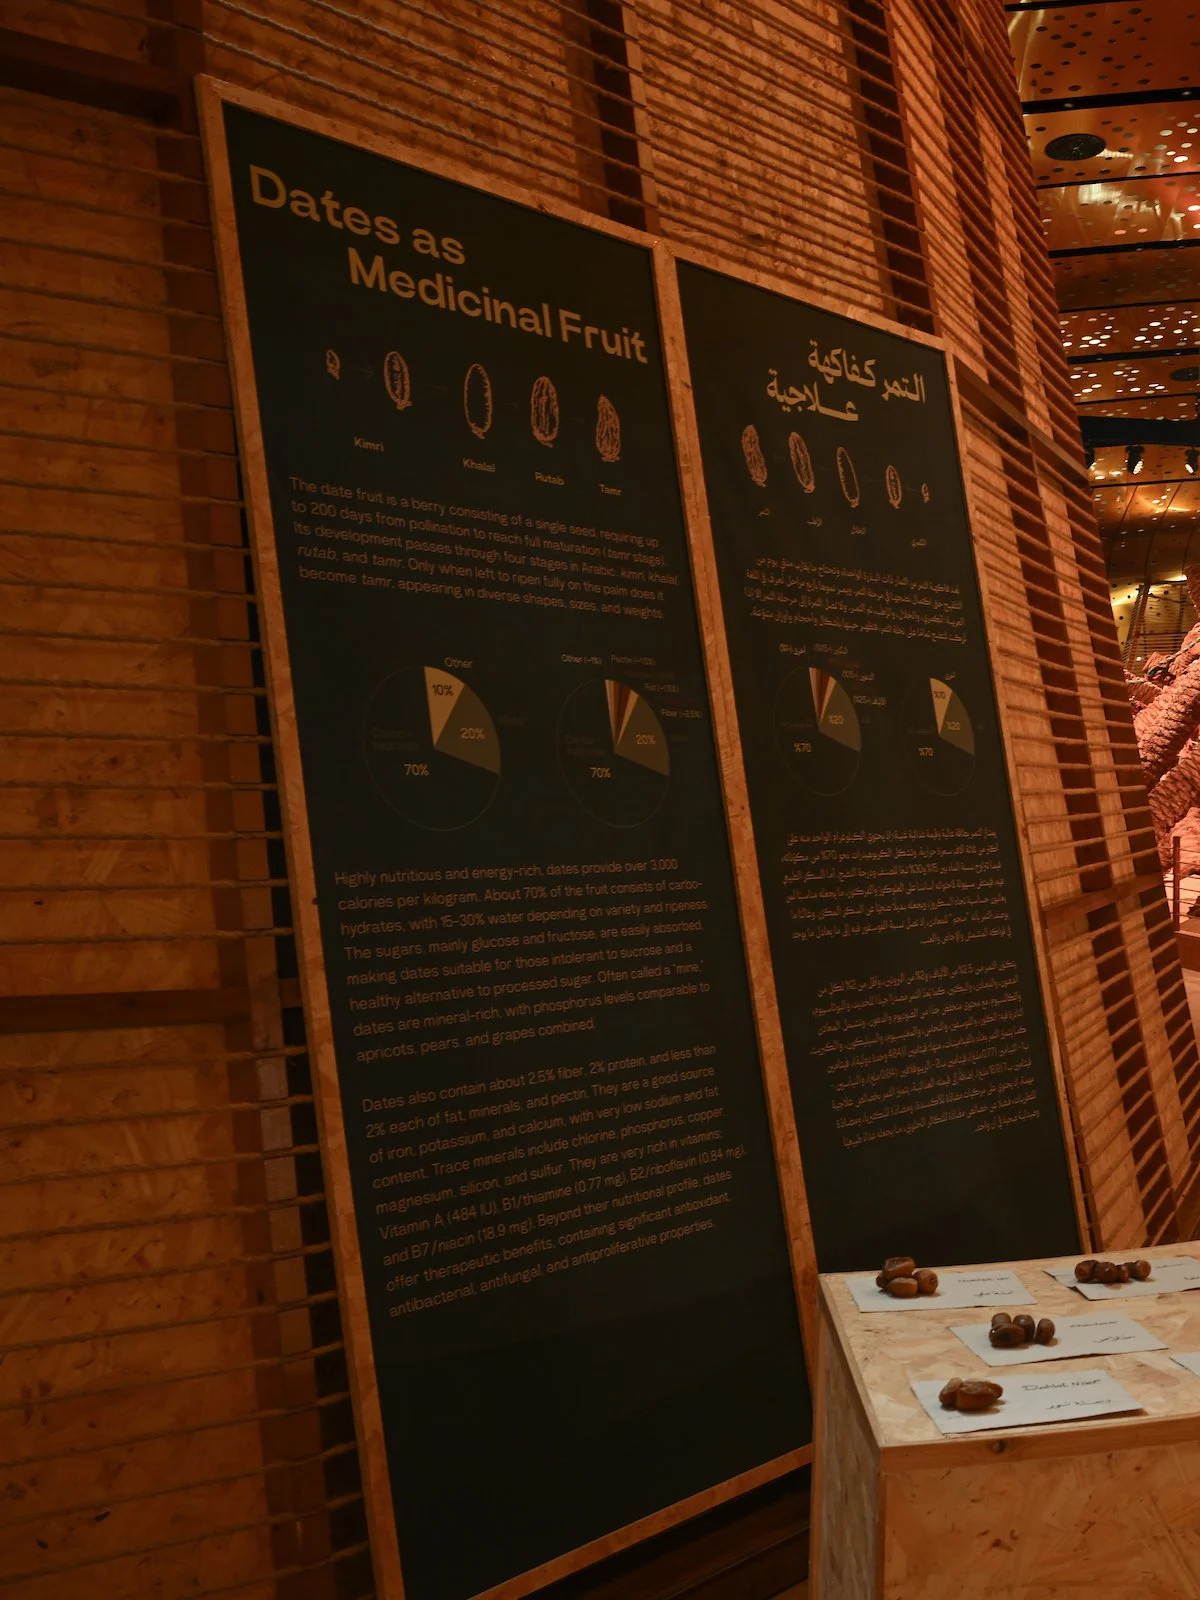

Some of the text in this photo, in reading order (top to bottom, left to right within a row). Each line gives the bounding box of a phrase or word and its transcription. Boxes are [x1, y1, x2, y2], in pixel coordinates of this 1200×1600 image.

[248, 163, 466, 265] Dates as
[348, 246, 649, 364] Medicinal Fruit
[806, 338, 926, 403] التمر كفاكهة
[766, 367, 860, 422] علاجية
[353, 437, 385, 452] Kimri
[462, 457, 496, 473] Khalal
[534, 470, 565, 486] Rutab
[291, 476, 567, 534] The date fruit is a berry consisting of a single
[598, 482, 623, 497] Tamr
[291, 500, 522, 544] to 200 days from to reach
[293, 520, 568, 571] Its development passes through four stages
[298, 565, 356, 584] become
[398, 580, 462, 598] appearing
[476, 587, 520, 602] diverse
[601, 603, 621, 614] and
[342, 551, 368, 564] and
[407, 557, 435, 575] Only
[438, 563, 473, 576] when
[474, 566, 495, 580] left
[497, 570, 510, 582] to
[567, 580, 581, 590] on
[630, 587, 656, 600] does
[432, 684, 454, 696] 10%
[460, 727, 485, 739] 20%
[635, 734, 656, 745] 20%
[403, 764, 429, 776] 70%
[589, 767, 612, 778] 70%
[334, 861, 647, 888] Highly nutritious and dates provide over
[338, 896, 394, 910] calories
[396, 895, 420, 909] per
[484, 888, 521, 901] About
[523, 886, 548, 899] 70%
[549, 884, 561, 898] of
[585, 883, 608, 895] fruit
[655, 879, 666, 892] of
[408, 916, 438, 930] with
[487, 912, 523, 924] water
[588, 907, 603, 917] on
[605, 903, 641, 916] variety
[643, 901, 663, 913] and
[346, 946, 372, 960] The
[428, 938, 468, 953] mainly
[471, 936, 519, 952] glucose
[522, 931, 545, 945] and
[599, 928, 618, 938] are
[346, 970, 397, 985] making
[400, 967, 439, 980] dates
[494, 958, 512, 970] for
[515, 956, 549, 968] those
[606, 949, 618, 960] to
[620, 946, 662, 958] sucrose
[664, 942, 684, 954] and
[685, 943, 693, 952] a
[349, 966, 671, 1010] healthy alternative to processed Often a
[352, 982, 710, 1036] dates are with phosphorus levels to
[465, 1031, 489, 1046] and
[492, 1027, 535, 1046] grapes
[362, 1049, 692, 1112] Dates also contain about 2% and less
[366, 1078, 650, 1138] 2% each of and They are a
[368, 1088, 703, 1164] of and with very low sodium and
[432, 1159, 470, 1175] Trace
[473, 1147, 524, 1167] minerals
[527, 1138, 569, 1156] include
[504, 1146, 644, 1186] and They are very
[379, 1205, 477, 1239] Vitamin A (484
[383, 1170, 732, 1266] and Beyond their dates
[386, 1222, 616, 1292] offer therapeutic containing
[546, 1256, 569, 1273] and
